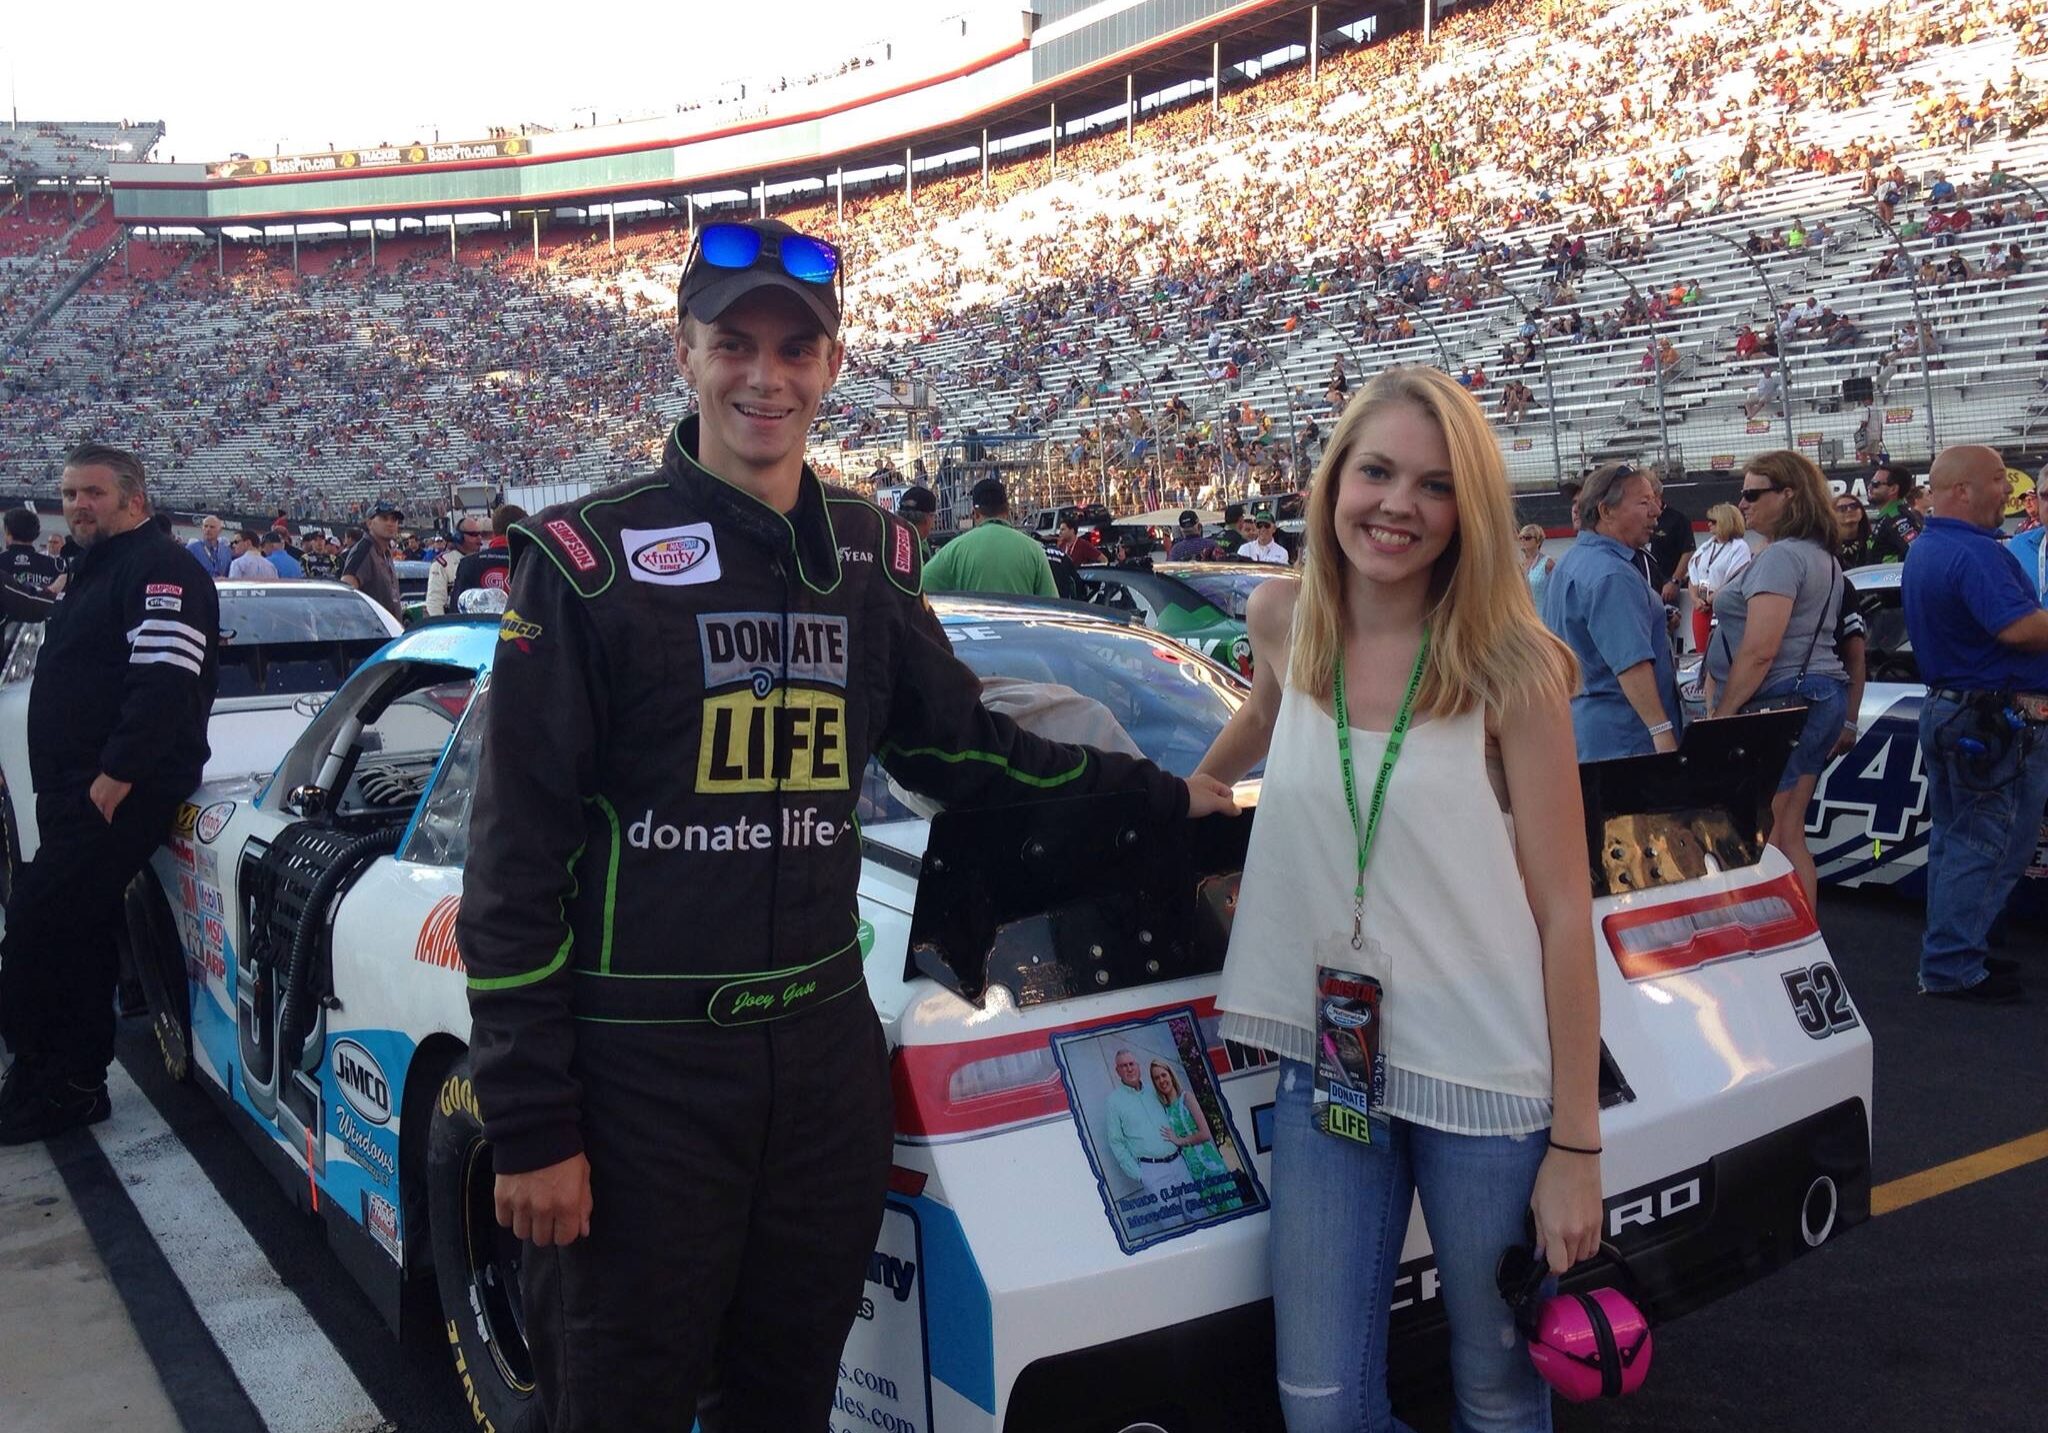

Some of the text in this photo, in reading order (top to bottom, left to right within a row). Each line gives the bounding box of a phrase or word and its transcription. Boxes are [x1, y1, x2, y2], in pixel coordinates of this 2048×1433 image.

[270, 155, 335, 174] BassPro.com
[428, 143, 497, 160] BassPro.com
[550, 520, 595, 570] SIMPSON
[643, 550, 695, 566] xfinity
[838, 551, 874, 563] YEAR
[897, 526, 910, 572] SIMPSON
[706, 621, 843, 664] DONATE
[709, 707, 841, 781] LIFE
[628, 808, 835, 851] donate life
[731, 980, 817, 1015] Joey Gase
[1780, 961, 1860, 1040] 52
[1332, 1084, 1366, 1108] DONATE
[336, 1104, 395, 1175] Windows
[1332, 1109, 1368, 1140] LIFE
[864, 1250, 916, 1303] ny
